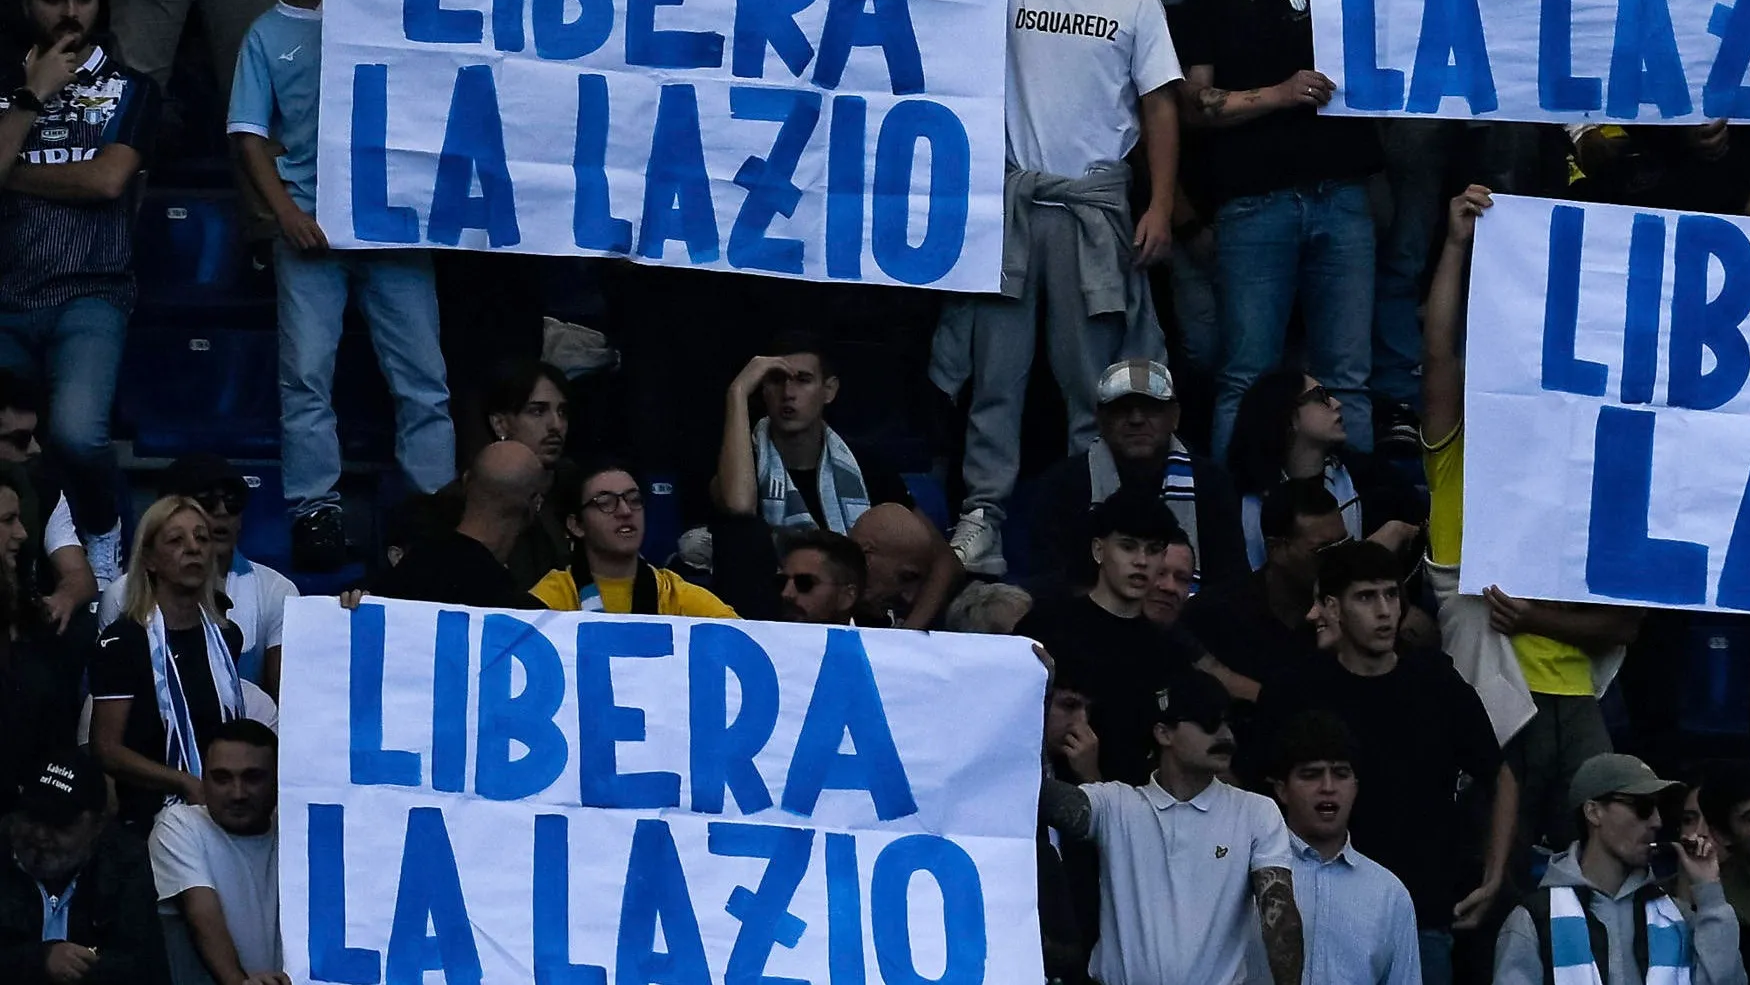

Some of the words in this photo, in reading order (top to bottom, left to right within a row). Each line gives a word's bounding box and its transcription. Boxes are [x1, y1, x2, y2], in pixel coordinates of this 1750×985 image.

[1015, 8, 1119, 41] DSQUARED2
[350, 63, 520, 249] LA
[572, 73, 971, 286] LAZIO
[349, 603, 920, 822] LIBERA
[307, 803, 484, 985] LA
[532, 813, 988, 985] LAZIO
